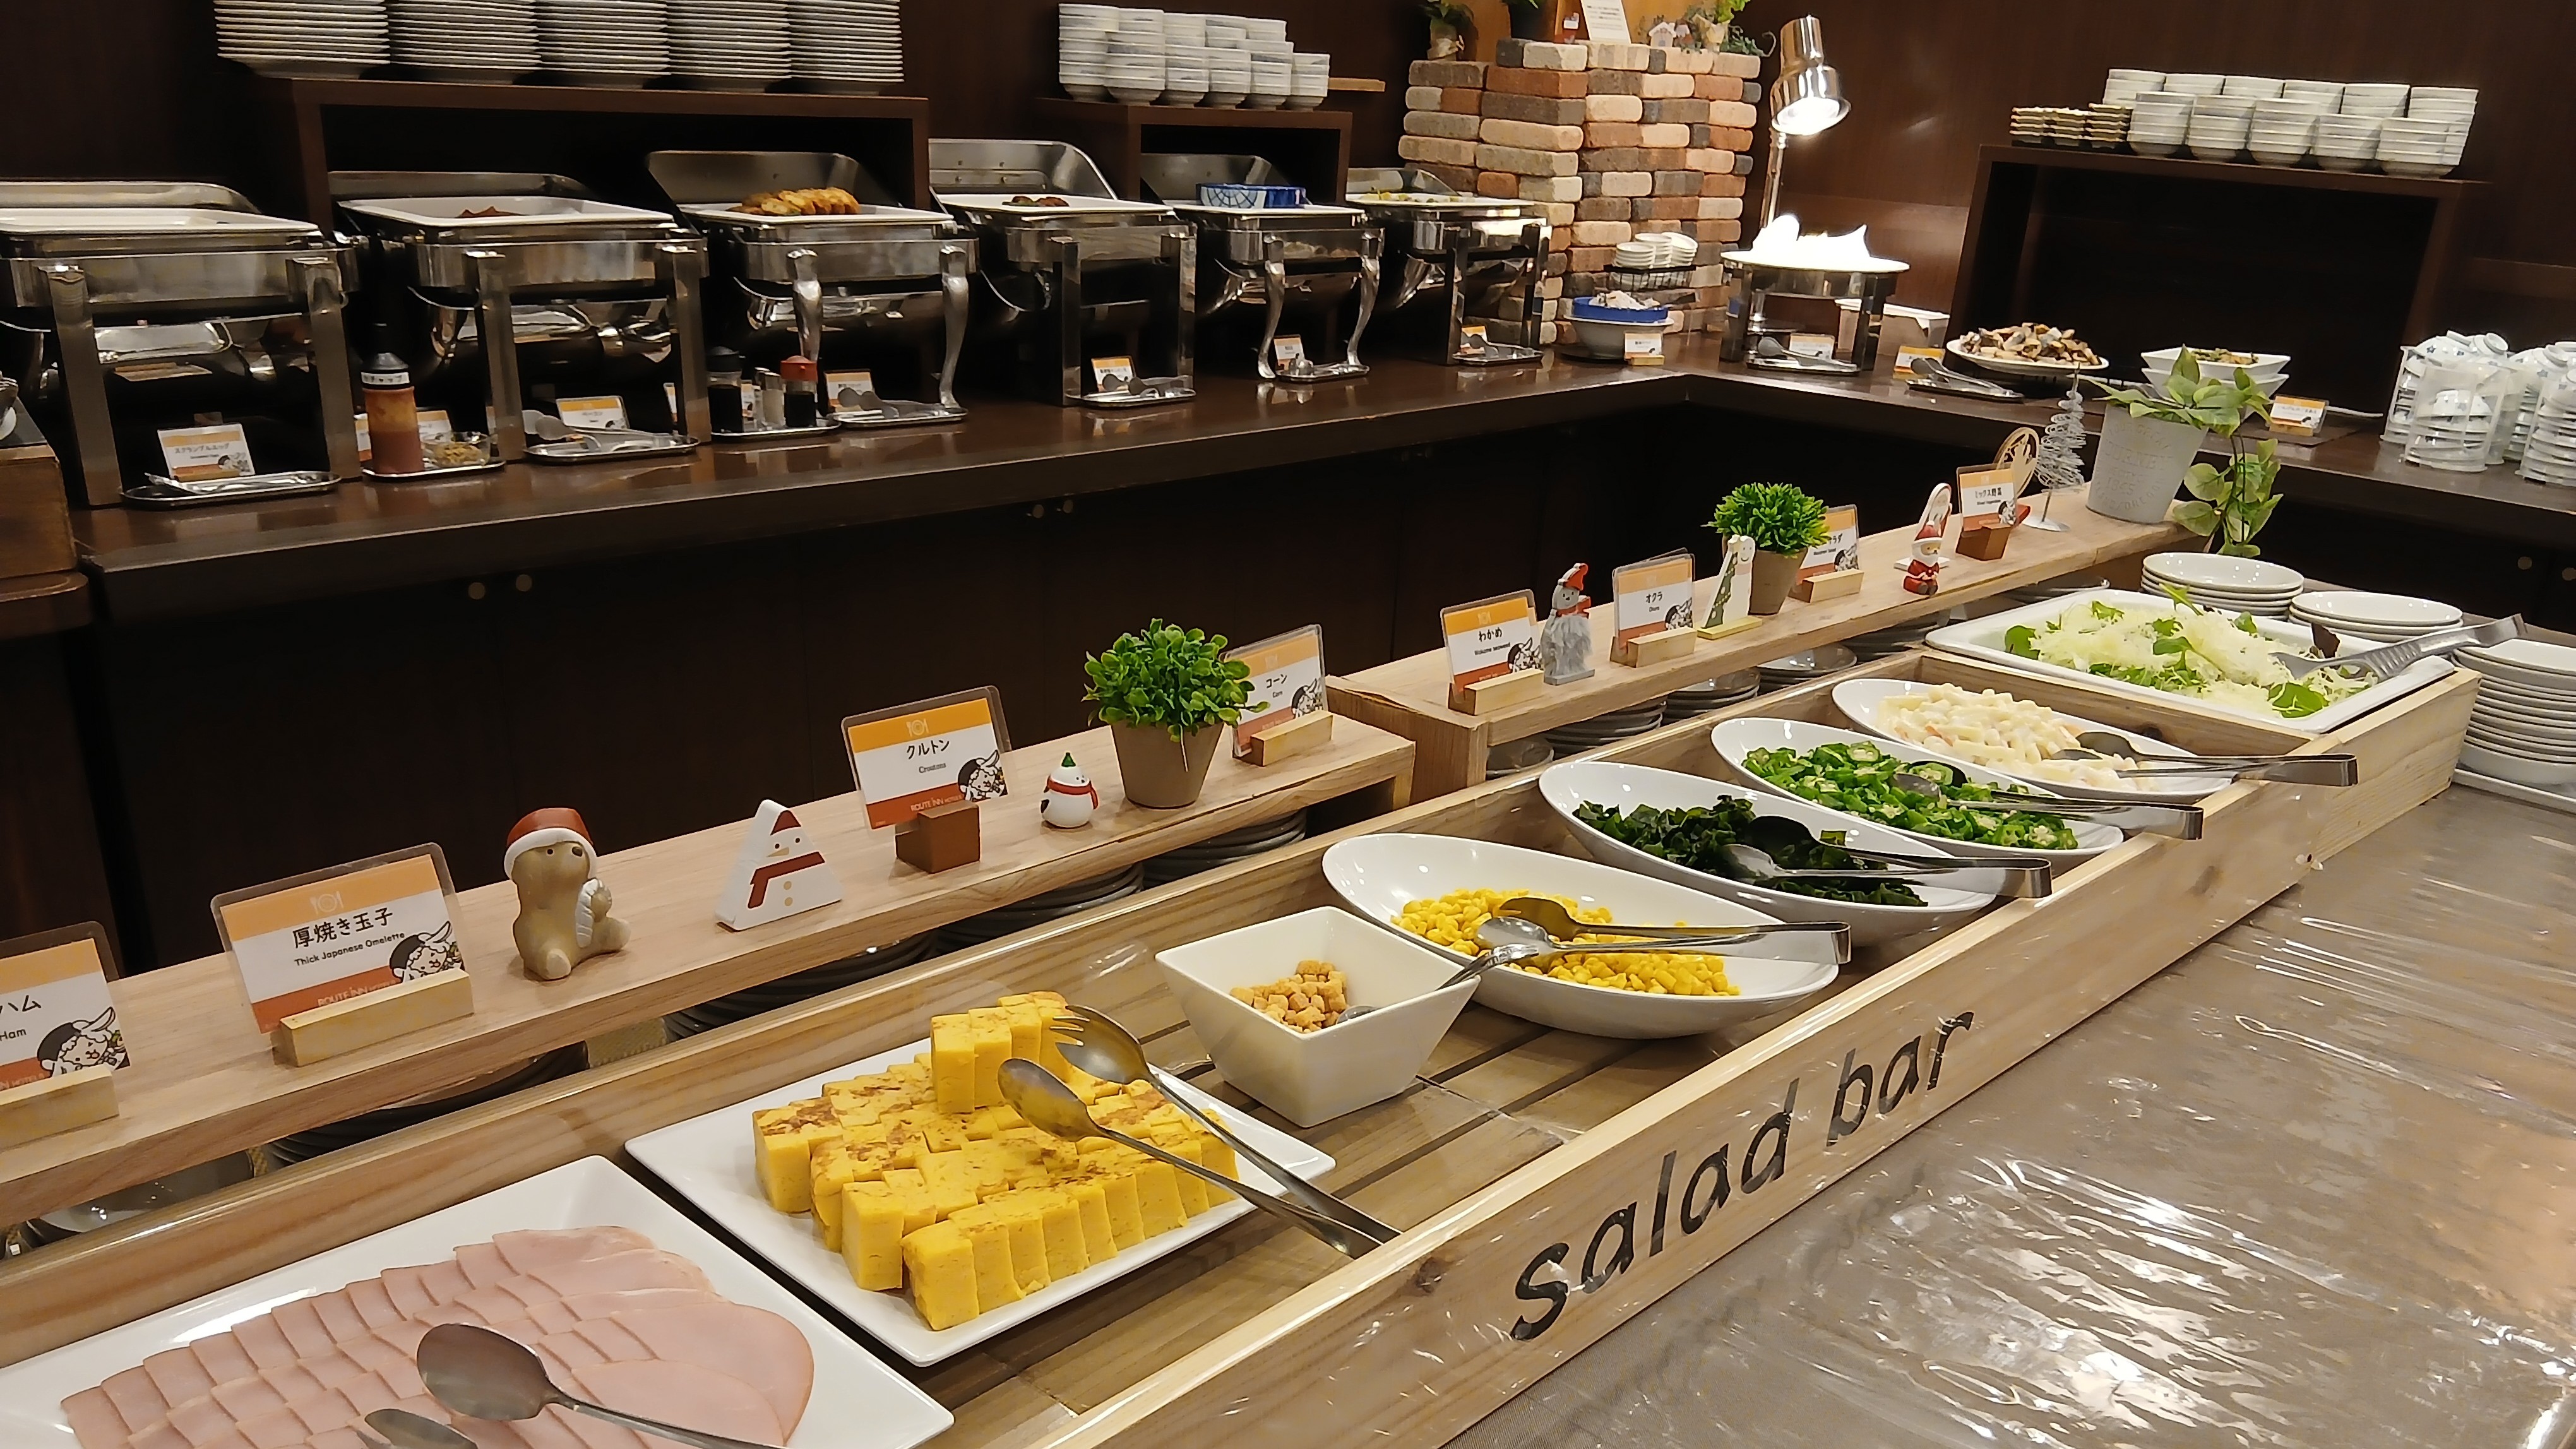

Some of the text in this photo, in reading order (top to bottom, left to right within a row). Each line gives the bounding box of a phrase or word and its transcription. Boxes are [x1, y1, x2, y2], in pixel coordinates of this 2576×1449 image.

[1645, 591, 1663, 604] オクラ
[1479, 626, 1503, 643] わかめ
[1265, 673, 1287, 689] コーン
[906, 739, 950, 760] クルトン
[292, 907, 393, 949] 厚焼き玉子
[294, 932, 405, 967] Thick Japanese Omelette
[1509, 1011, 1974, 1341] salad bar
